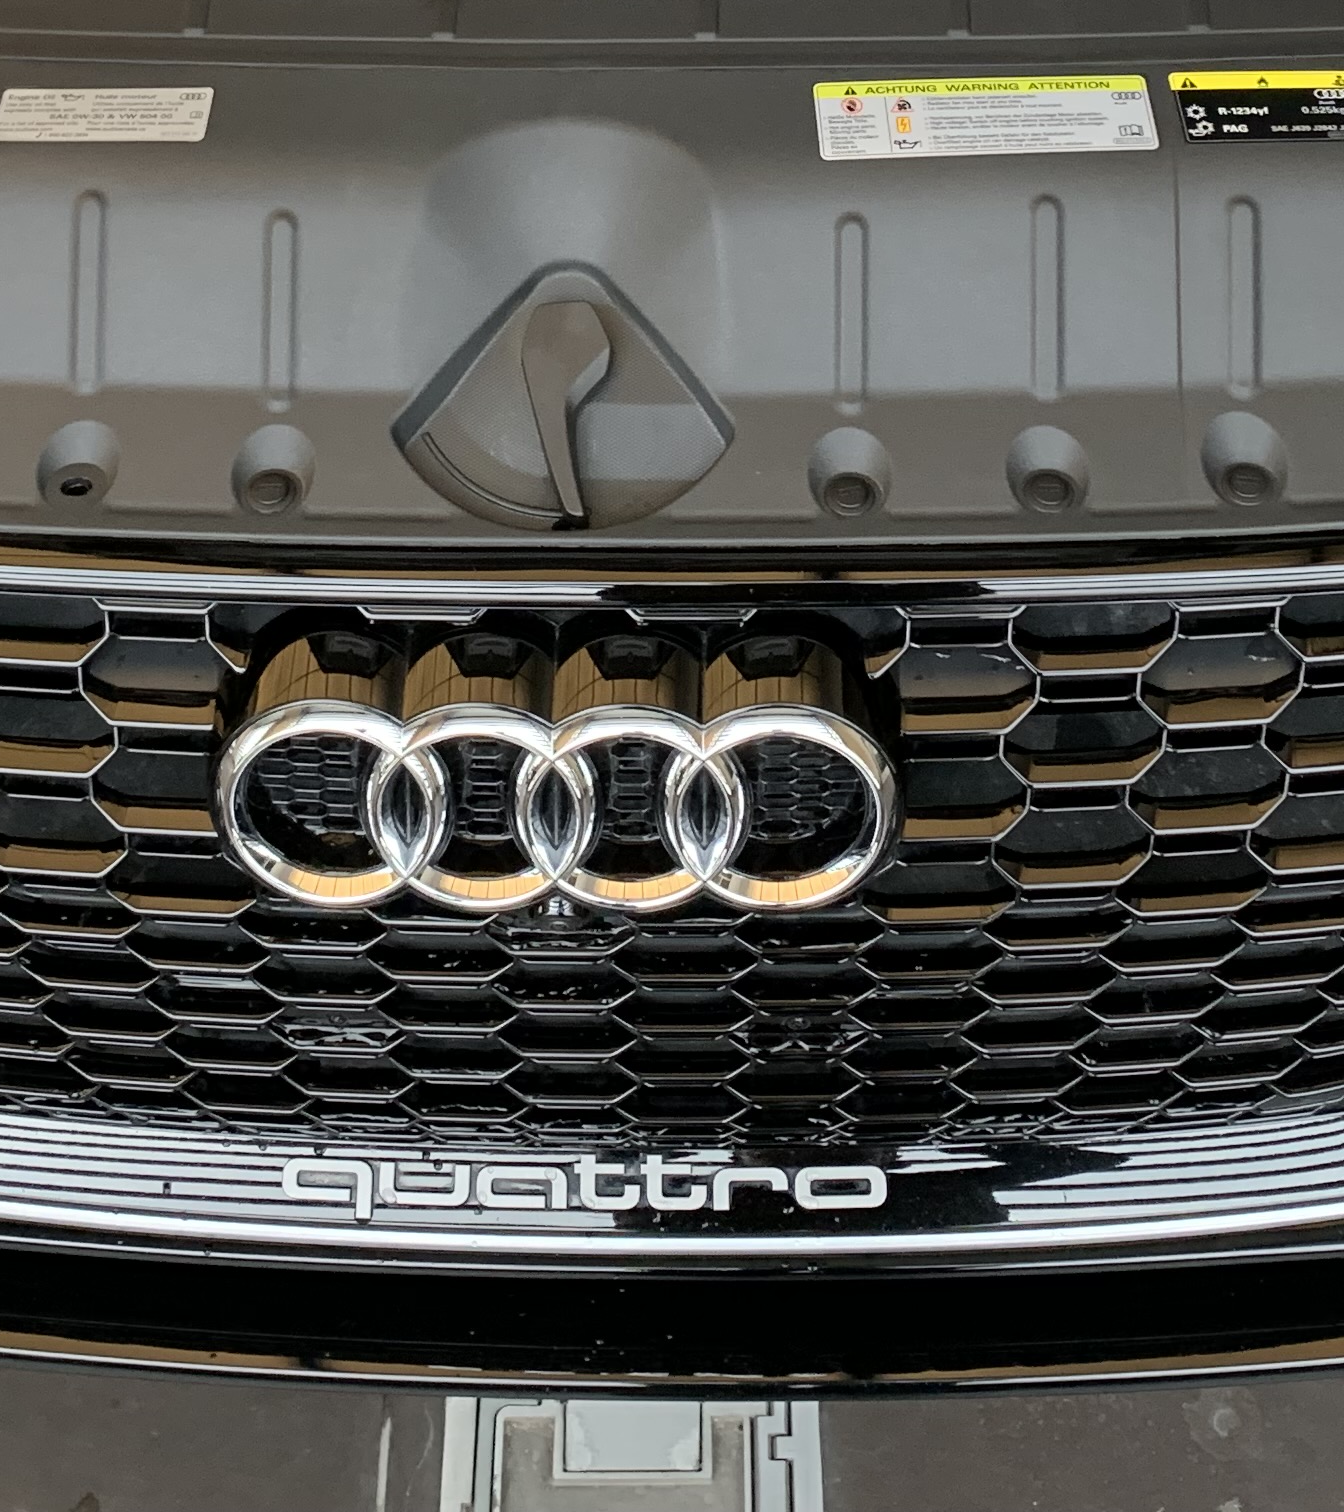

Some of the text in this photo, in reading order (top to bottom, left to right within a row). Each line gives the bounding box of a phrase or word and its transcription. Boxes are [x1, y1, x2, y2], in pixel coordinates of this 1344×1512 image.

[865, 81, 1110, 95] ACHTUNG WARNING ATTENTION
[1218, 107, 1269, 116] R-1234yf
[1222, 124, 1249, 133] PAG
[282, 1155, 887, 1220] quattro
